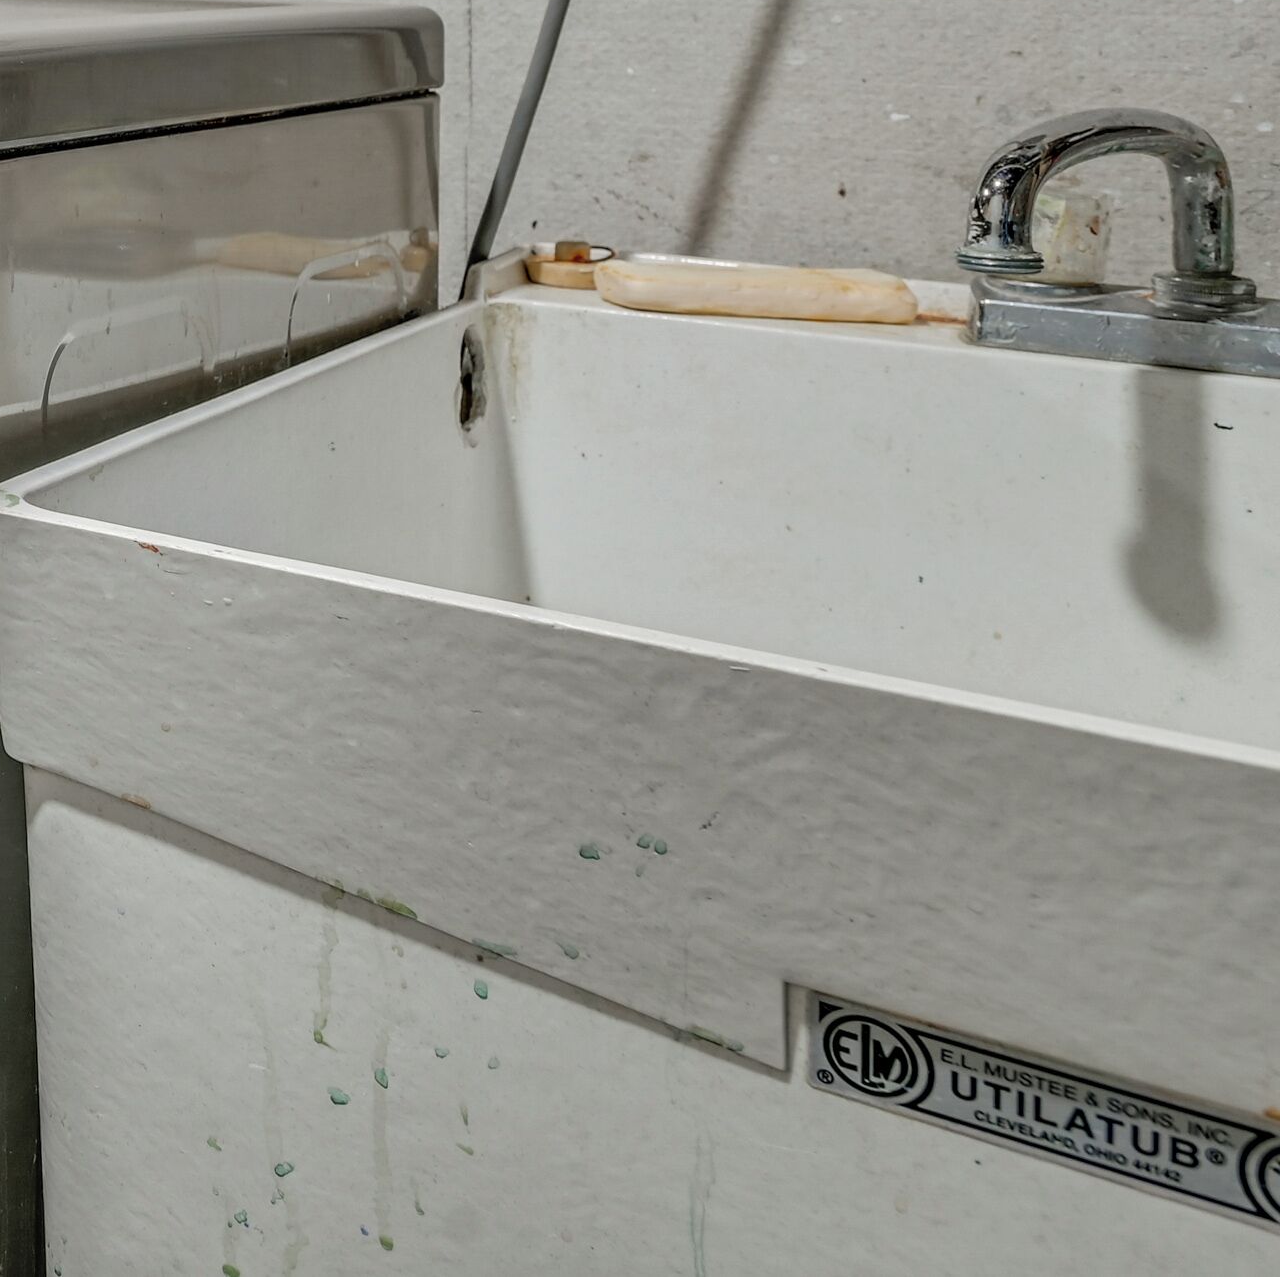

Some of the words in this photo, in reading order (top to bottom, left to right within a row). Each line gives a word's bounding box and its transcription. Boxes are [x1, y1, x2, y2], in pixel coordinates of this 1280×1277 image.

[940, 1048, 978, 1072] E.L.
[984, 1061, 1078, 1101] MUSTEE
[1084, 1093, 1099, 1107] &
[1187, 1121, 1235, 1147] INC.
[1083, 1143, 1127, 1166] OHIO
